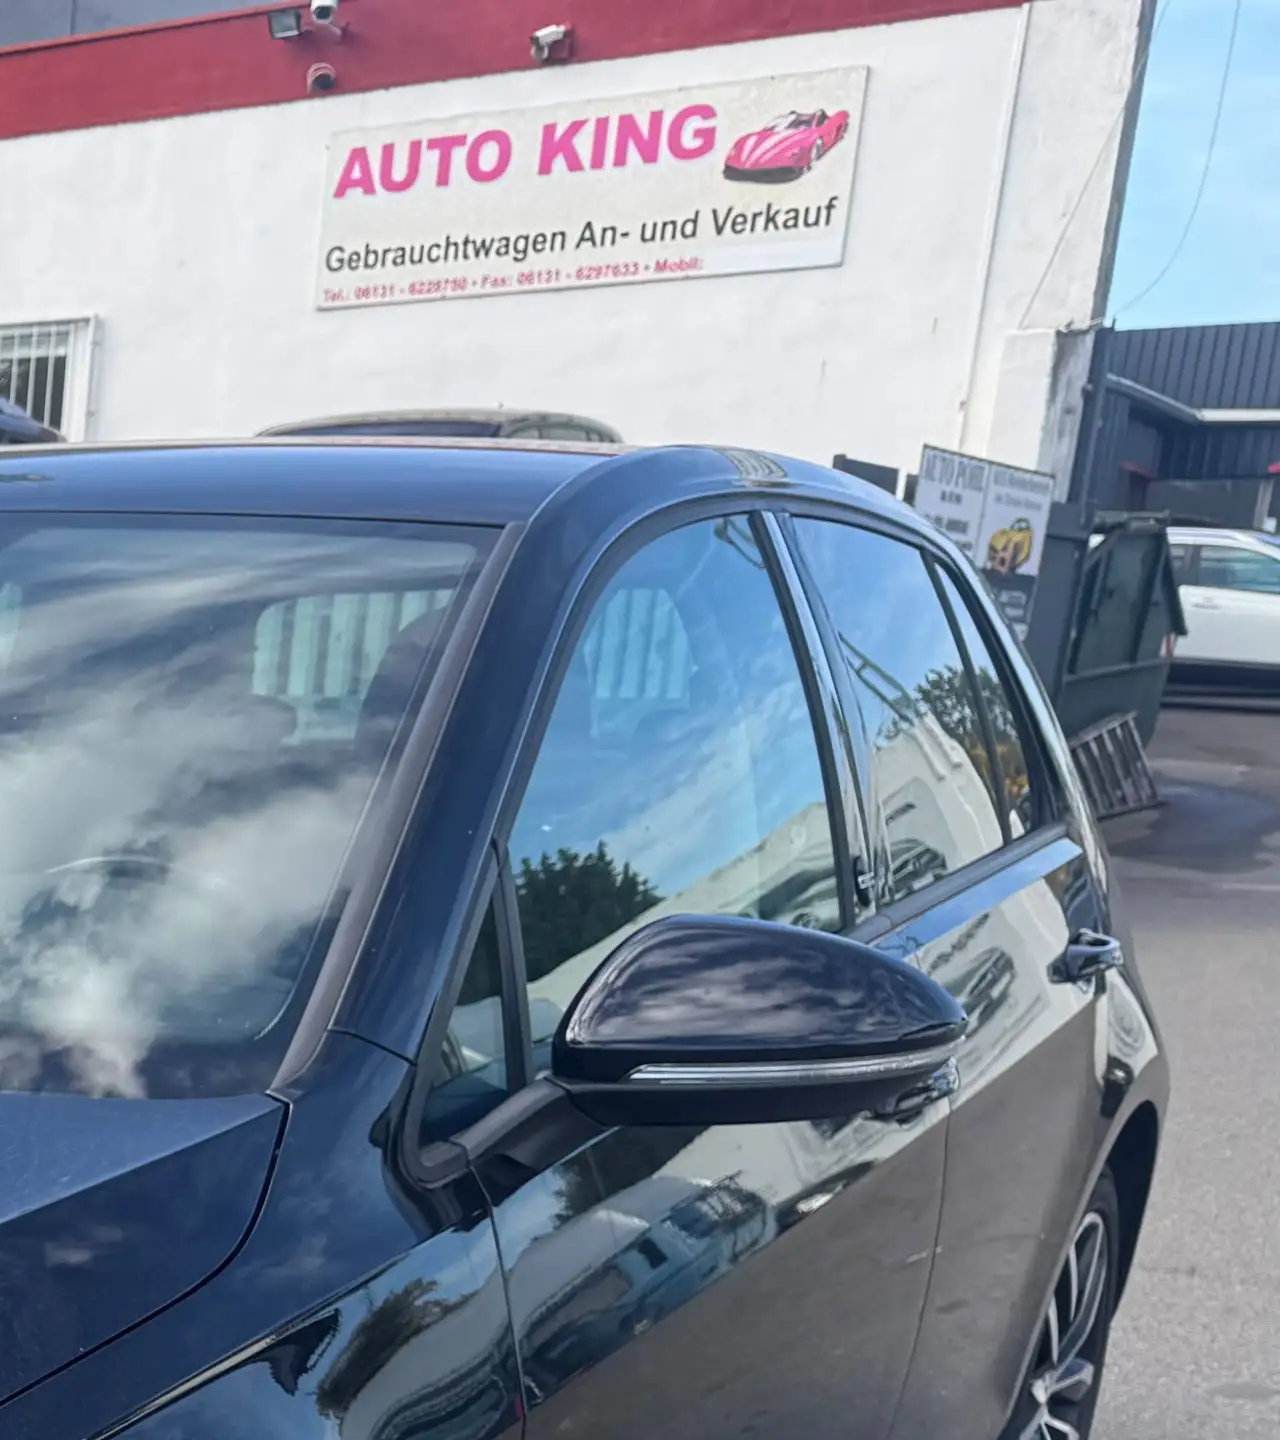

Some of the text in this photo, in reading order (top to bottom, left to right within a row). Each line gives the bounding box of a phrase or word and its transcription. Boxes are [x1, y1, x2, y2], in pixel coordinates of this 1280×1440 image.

[332, 103, 718, 200] AUTO KING
[325, 196, 839, 273] Gebrauchtwagen An- und Verkauf
